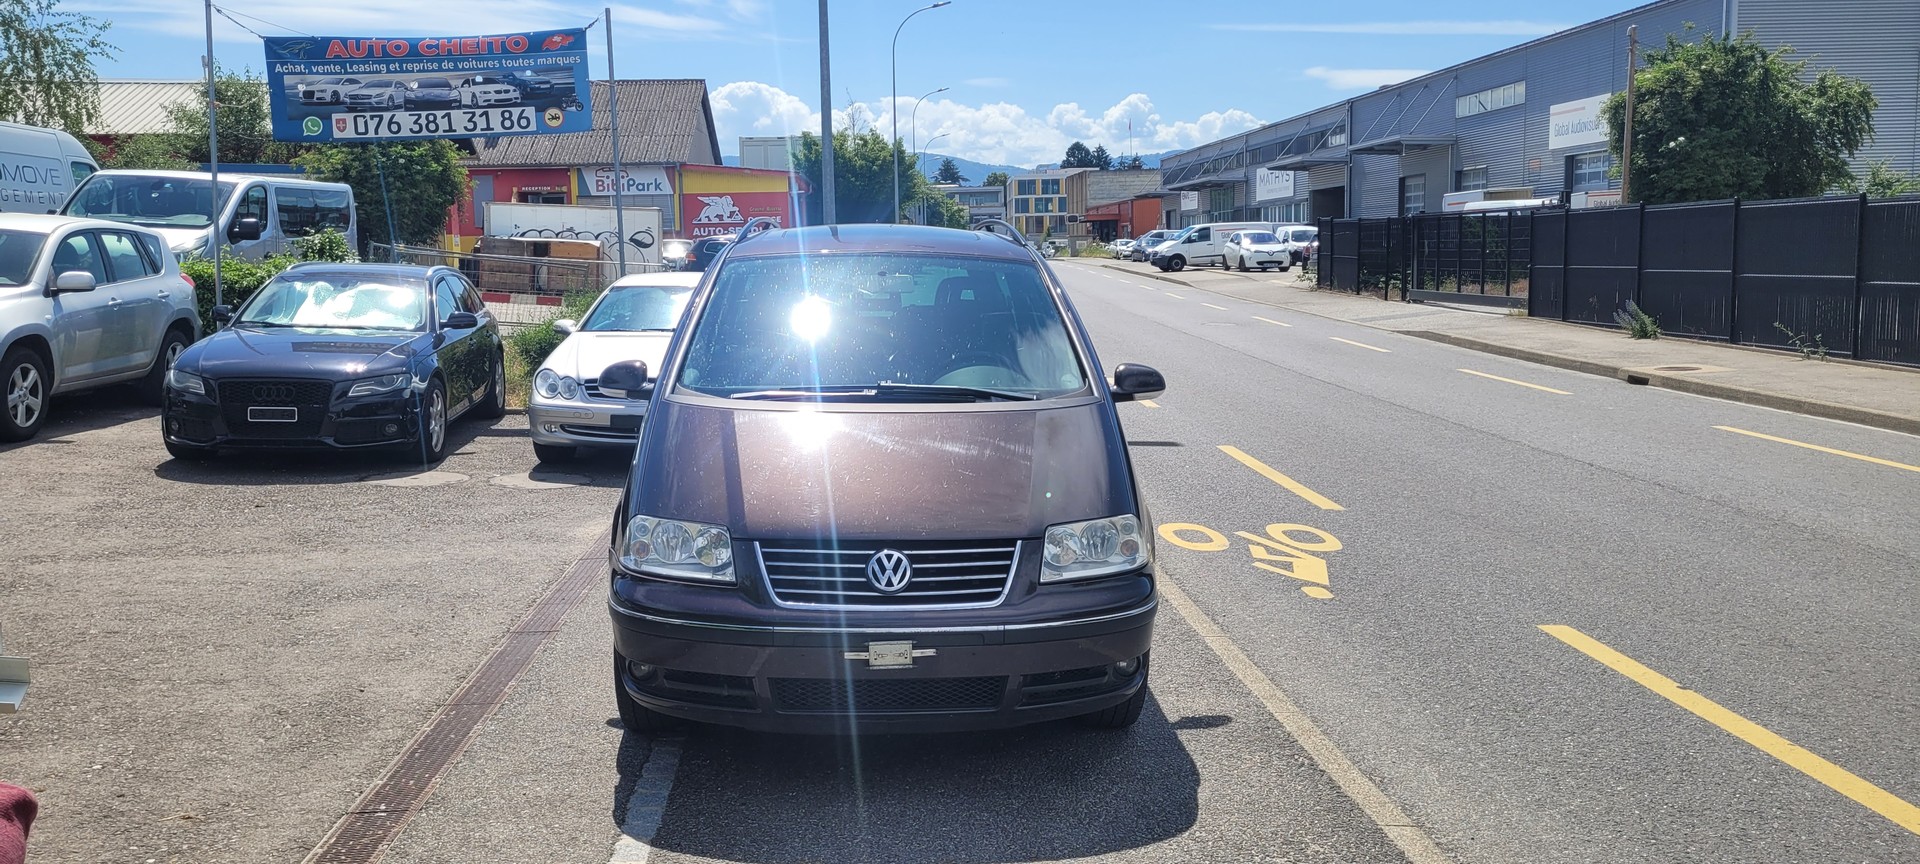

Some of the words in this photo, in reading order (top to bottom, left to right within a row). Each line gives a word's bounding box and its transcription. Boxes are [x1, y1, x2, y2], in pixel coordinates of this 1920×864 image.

[326, 39, 410, 59] AUTO
[418, 35, 529, 56] CHEITO
[275, 63, 309, 74] Achat,
[311, 64, 345, 74] vente,
[347, 61, 387, 73] Leasing
[389, 62, 401, 71] et
[403, 59, 439, 72] reprise
[441, 59, 455, 70] de
[457, 58, 500, 69] voitures
[502, 57, 535, 67] toutes
[537, 55, 581, 66] marques
[353, 113, 402, 136] 076
[408, 112, 457, 134] 381
[463, 110, 495, 132] 31
[500, 109, 531, 130] 86
[1554, 121, 1570, 137] Global
[1259, 171, 1291, 187] MATHYS
